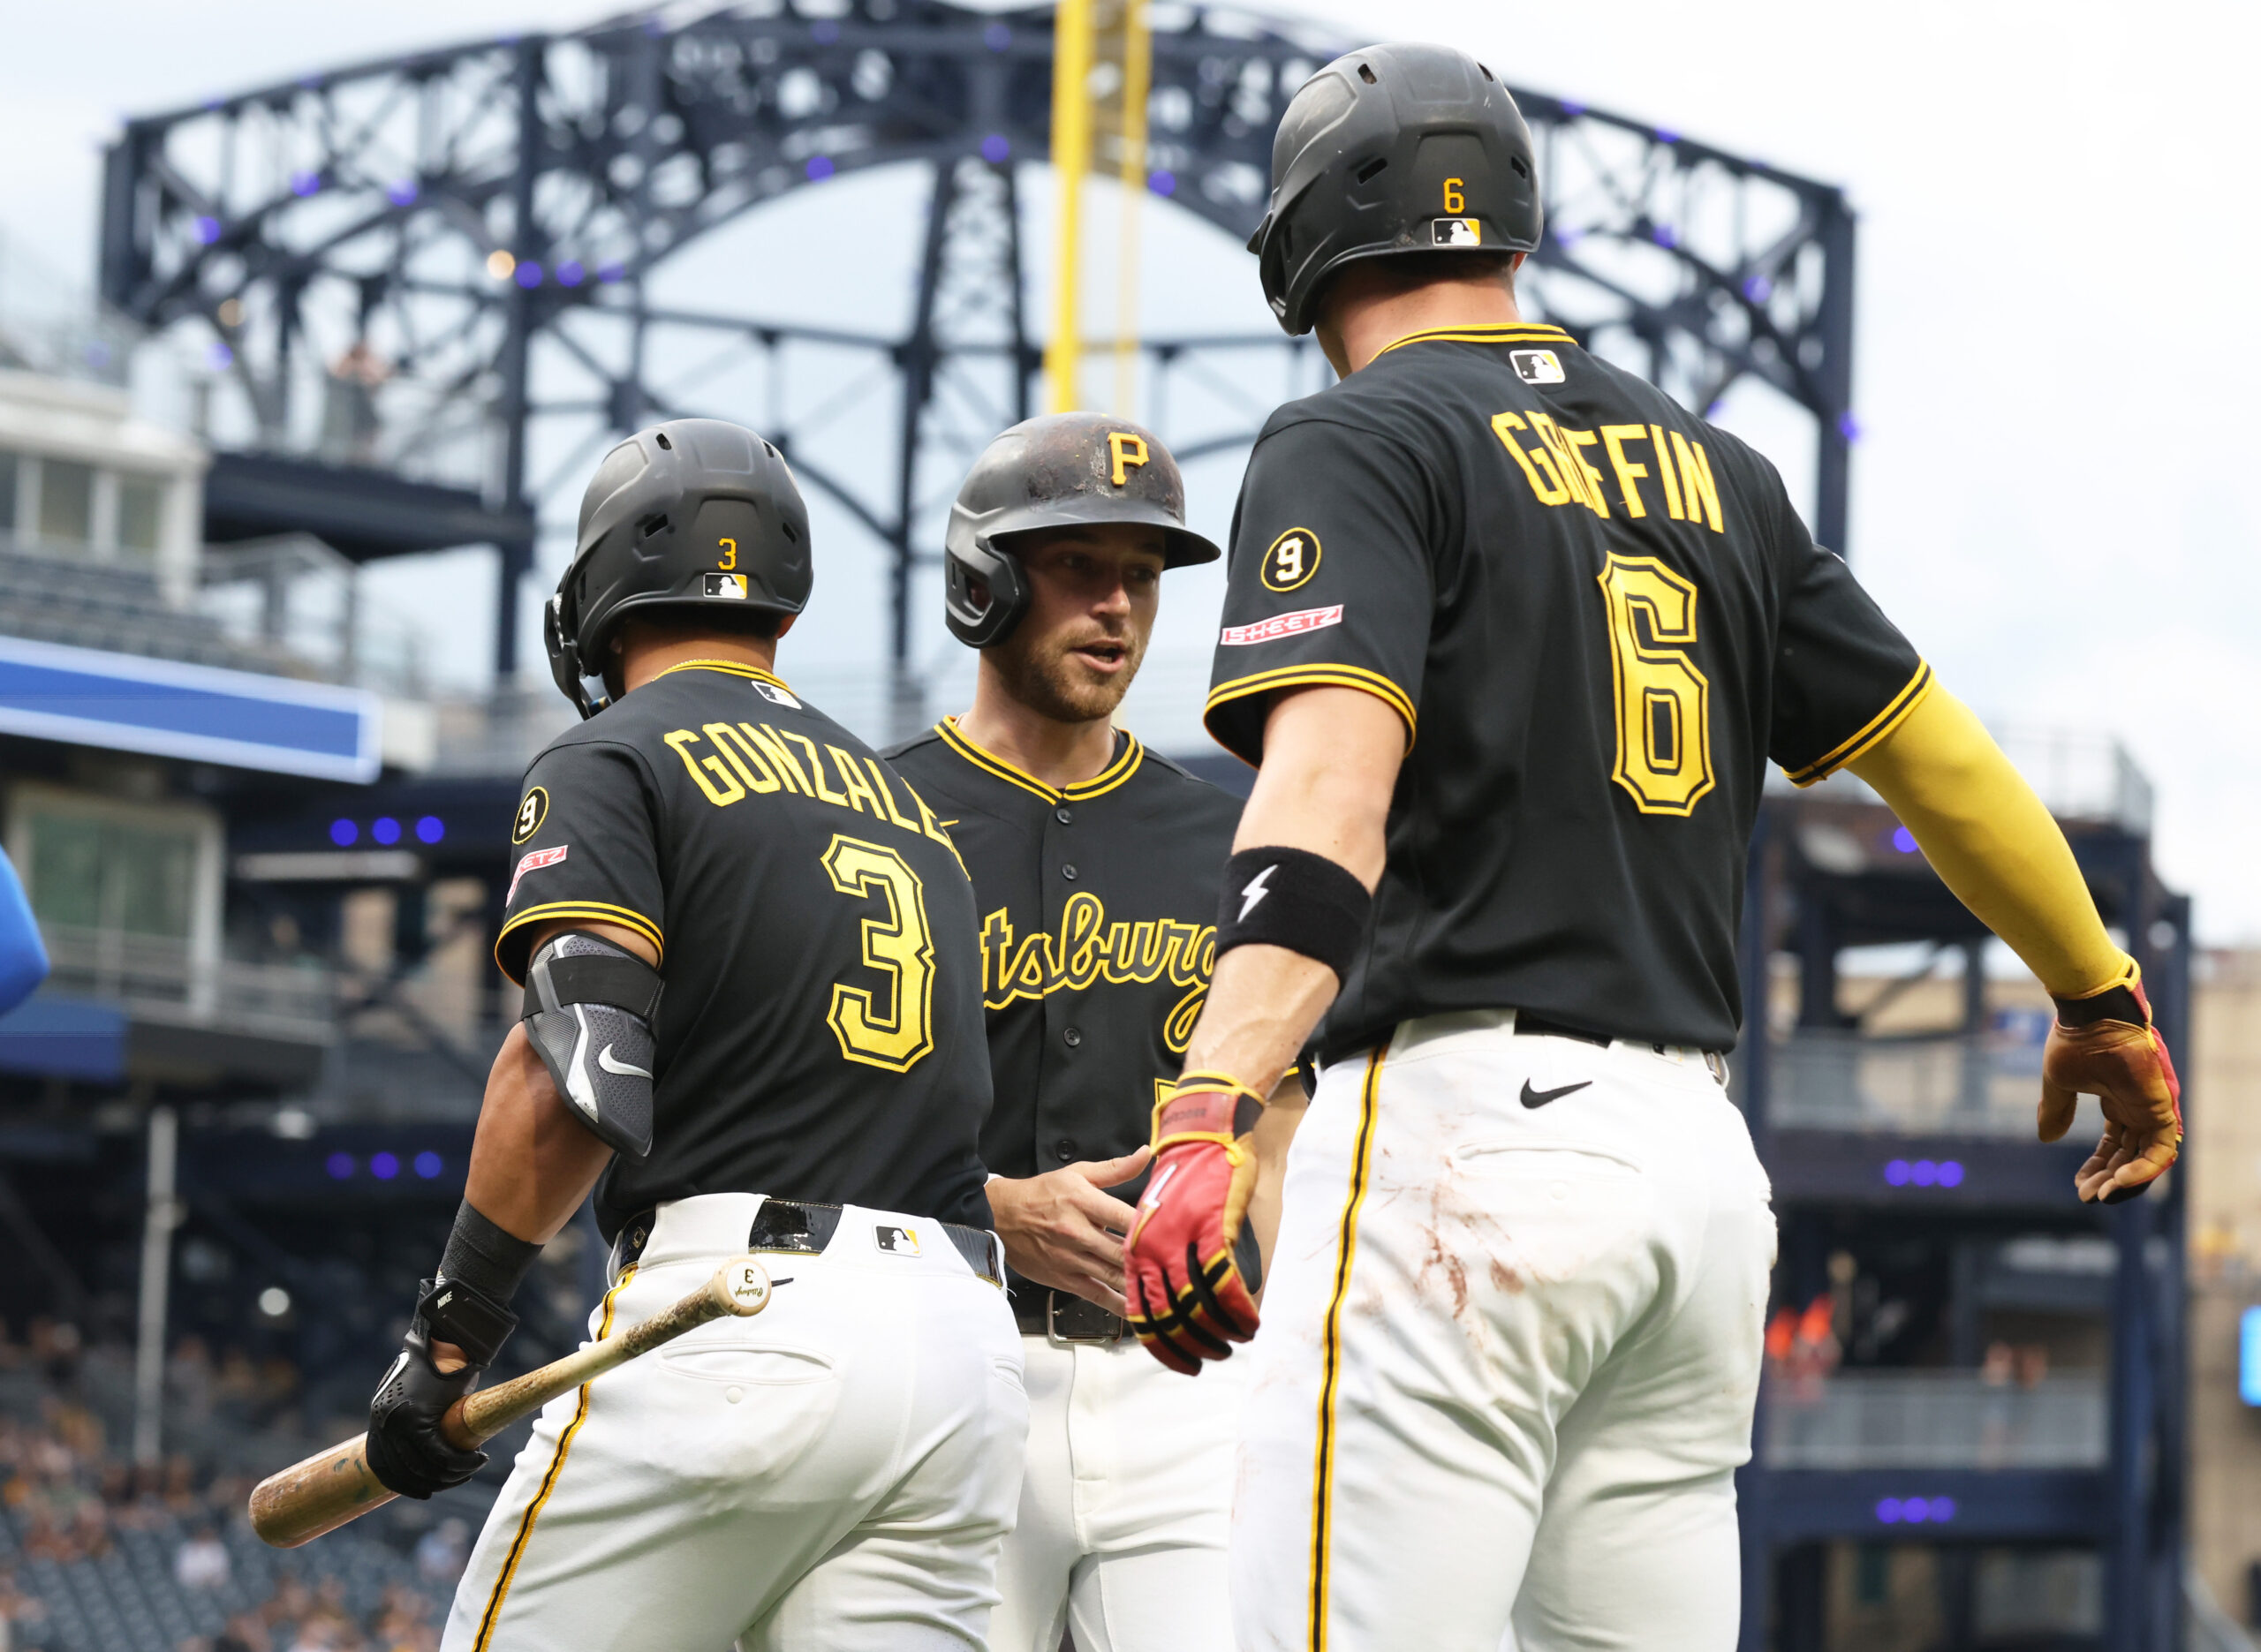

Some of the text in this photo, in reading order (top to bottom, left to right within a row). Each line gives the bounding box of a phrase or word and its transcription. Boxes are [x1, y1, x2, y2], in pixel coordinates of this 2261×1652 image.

[1442, 177, 1466, 215] 6
[1107, 432, 1150, 487] P
[717, 537, 737, 571] 3
[1275, 537, 1304, 583] 9
[1228, 608, 1338, 643] SHEETZ
[1597, 550, 1717, 818] 6
[519, 795, 538, 836] 9
[664, 721, 971, 882] GONZALE
[820, 833, 937, 1074] 3
[744, 1268, 754, 1285] 3
[436, 1290, 453, 1309] NIKE
